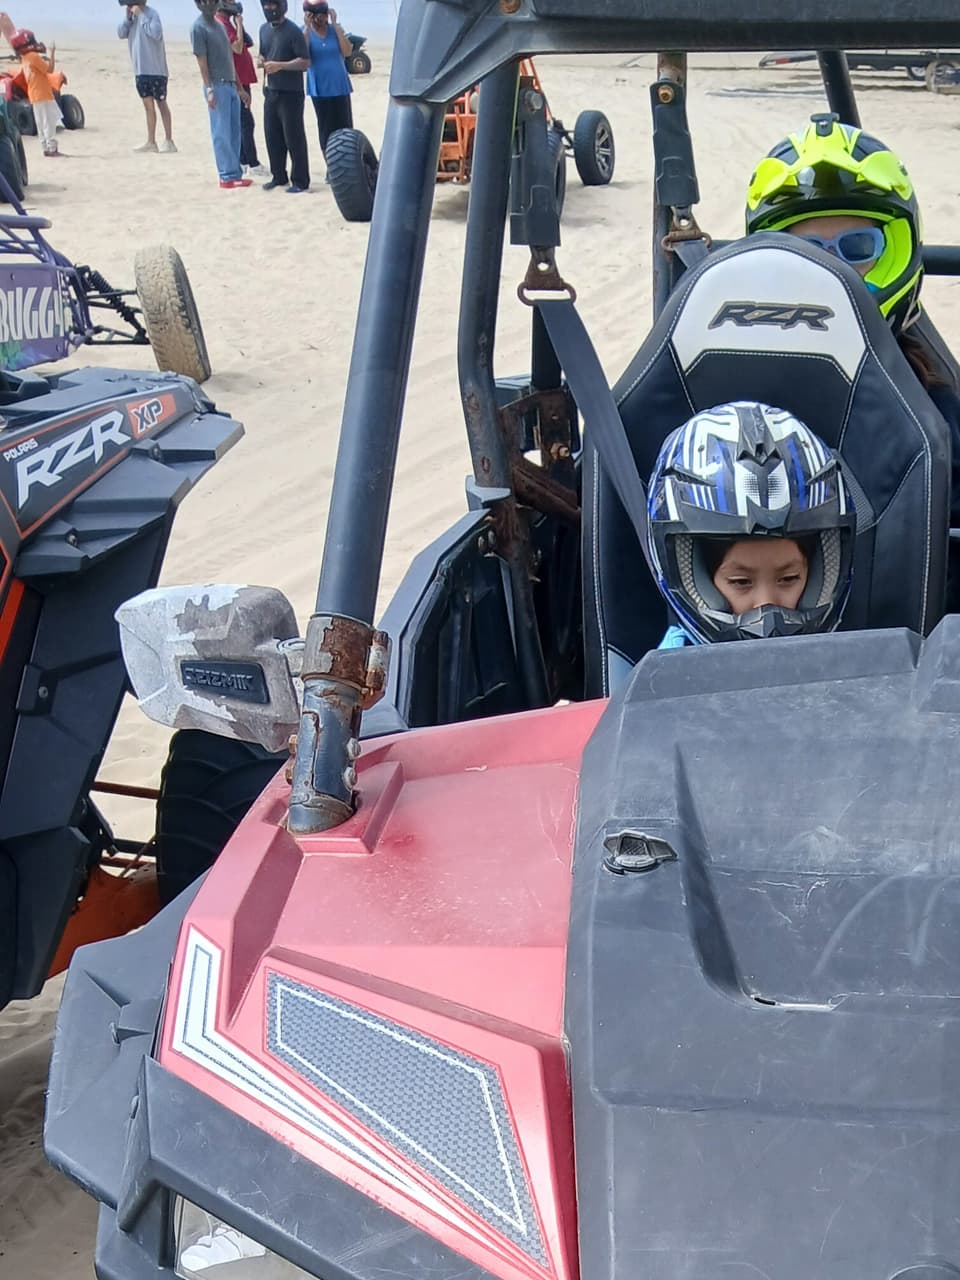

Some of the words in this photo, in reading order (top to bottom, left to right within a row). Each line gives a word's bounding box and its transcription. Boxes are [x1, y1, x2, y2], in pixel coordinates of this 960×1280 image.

[707, 300, 835, 331] RZR
[131, 398, 163, 433] XP
[3, 438, 39, 462] POLARIS
[16, 410, 131, 509] RZR
